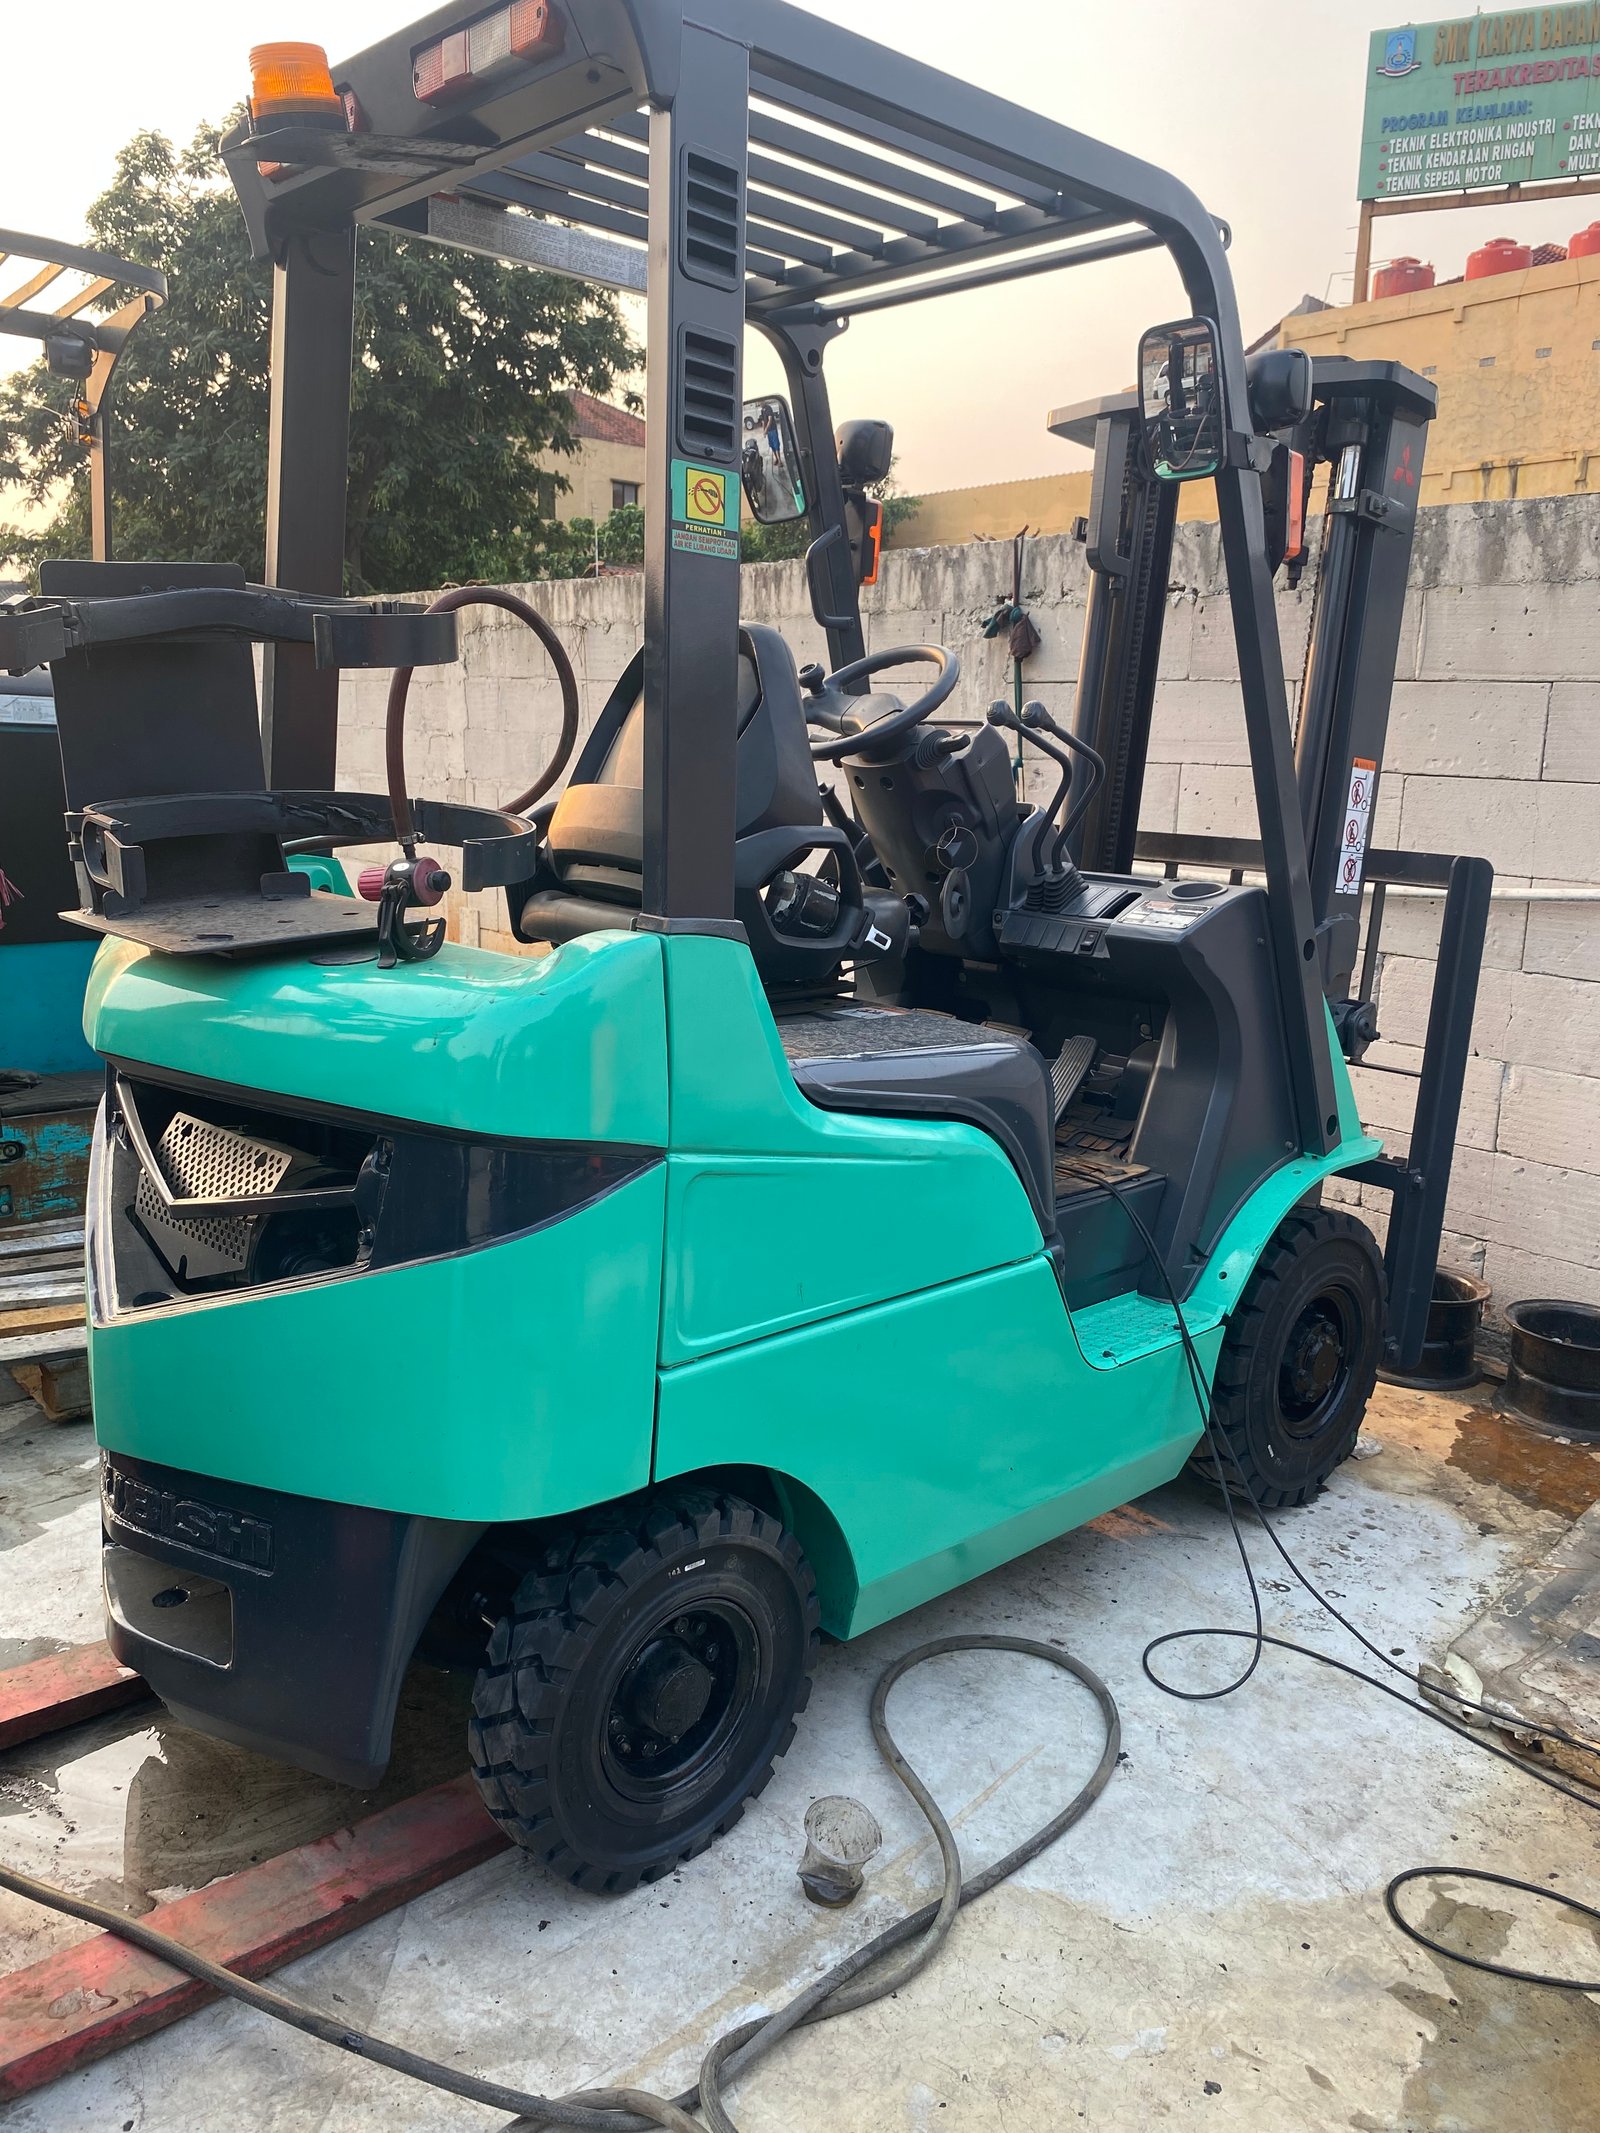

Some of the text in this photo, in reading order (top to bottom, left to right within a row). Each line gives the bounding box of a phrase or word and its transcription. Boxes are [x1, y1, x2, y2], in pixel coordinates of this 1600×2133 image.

[1434, 22, 1472, 65] SMK
[1476, 12, 1535, 57] KARYA
[1381, 109, 1449, 133] PROGRAM
[1389, 118, 1556, 154] TEKNIK ELEKTRONIKA INDUSTRI
[1568, 133, 1593, 152] DAN
[1387, 141, 1535, 173] TEKNIK KENDARAAN RINGAN
[1385, 164, 1502, 192] TEKNIK SEPEDA MOTOR
[685, 523, 723, 537] PERHATIAN
